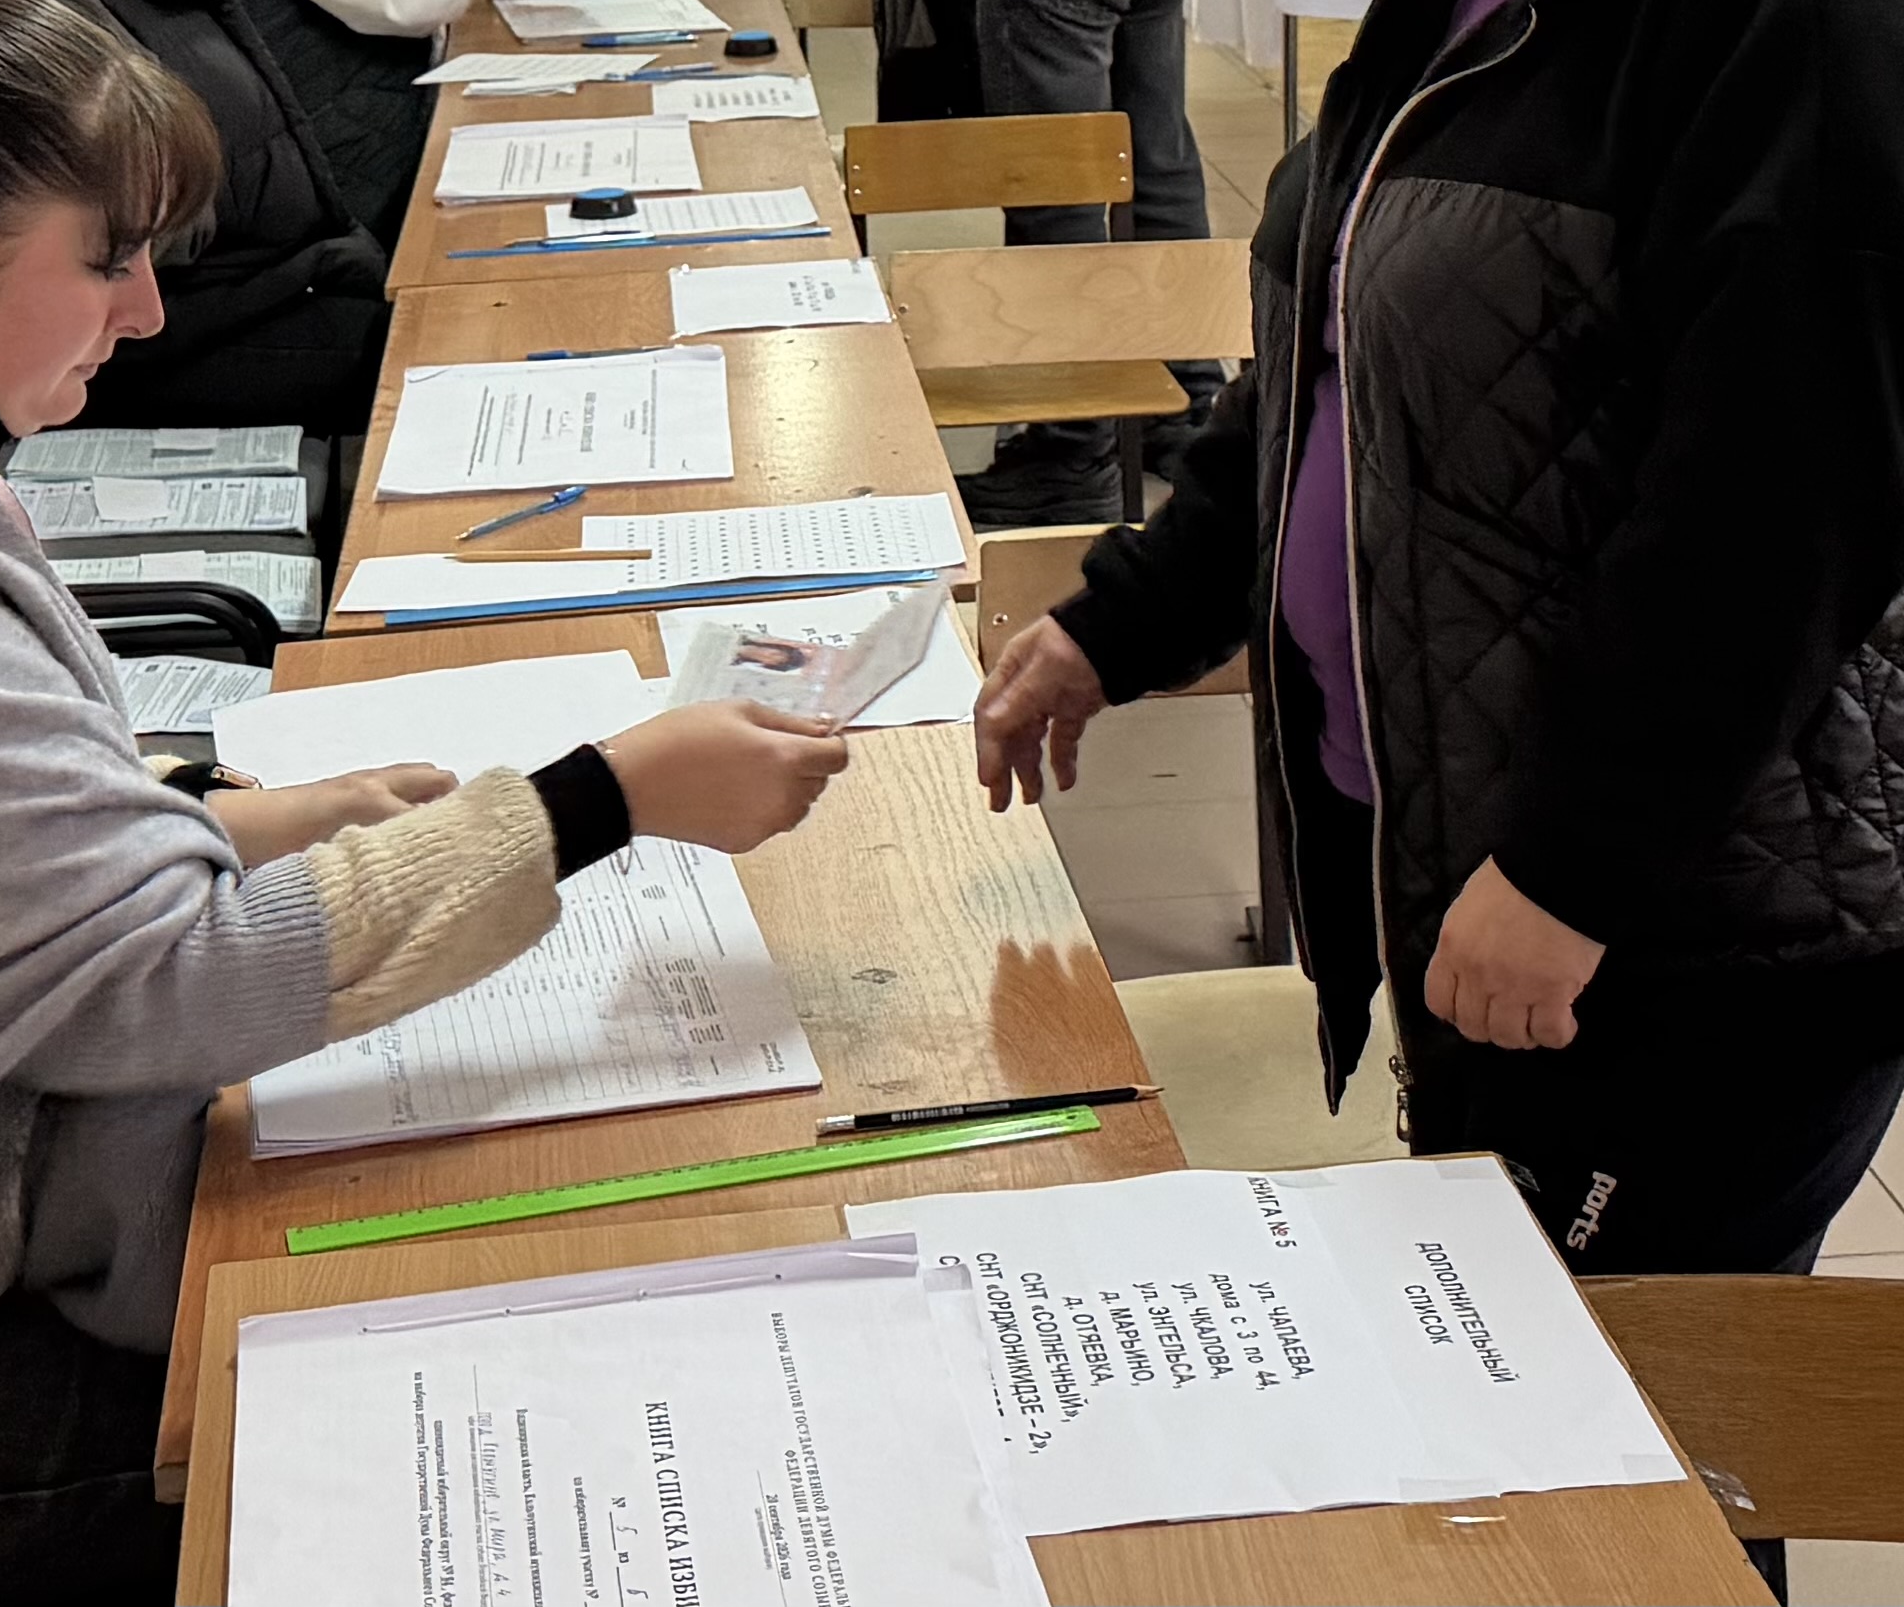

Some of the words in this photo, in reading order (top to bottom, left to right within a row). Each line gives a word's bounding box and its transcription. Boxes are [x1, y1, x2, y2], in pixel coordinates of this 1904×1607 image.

[1268, 1220, 1290, 1238] №
[1276, 1238, 1297, 1248] 5
[976, 1252, 1004, 1280] СНТ
[1019, 1272, 1050, 1300] СНТ
[1208, 1274, 1240, 1309] дома
[1063, 1296, 1084, 1310] д.
[1099, 1291, 1121, 1306] д.
[1231, 1315, 1247, 1324] с
[1404, 1284, 1454, 1345] СПИСОК
[1415, 1242, 1521, 1383] ДОПОЛНИТЕЛЬНЫЙ
[771, 1312, 790, 1353] ВЫБОРЫ
[987, 1283, 1045, 1416] «ОРДЖОНИКИДЗЕ
[1072, 1314, 1114, 1387] ОТЯЕВКА,
[1109, 1307, 1155, 1387] МАРЬИНО,
[1133, 1281, 1156, 1304] ул.
[1148, 1306, 1197, 1389] ЭНГЕЛЬСА,
[1173, 1282, 1195, 1305] ул.
[1189, 1305, 1234, 1380] ЧКАЛОВА,
[1238, 1329, 1258, 1340] 3
[1243, 1346, 1265, 1365] по
[1249, 1281, 1272, 1304] ул.
[1269, 1305, 1314, 1380] ЧАПАЕВА,
[780, 1355, 804, 1407] ДЕПУТАТОВ
[1031, 1304, 1090, 1423] «СОЛНЕЧНЫЙ»,
[645, 1401, 676, 1463] КНИГА
[794, 1409, 831, 1513] ГОСУДАРСТВЕННОЙ
[656, 1469, 689, 1552] СПИСКА
[784, 1450, 810, 1514] ФЕДЕРАЦИИ
[797, 1515, 823, 1573] ДЕВЯТОГО
[816, 1515, 836, 1548] ДУМЫ
[826, 1551, 853, 1607] ФЕДЕРАЛЬ
